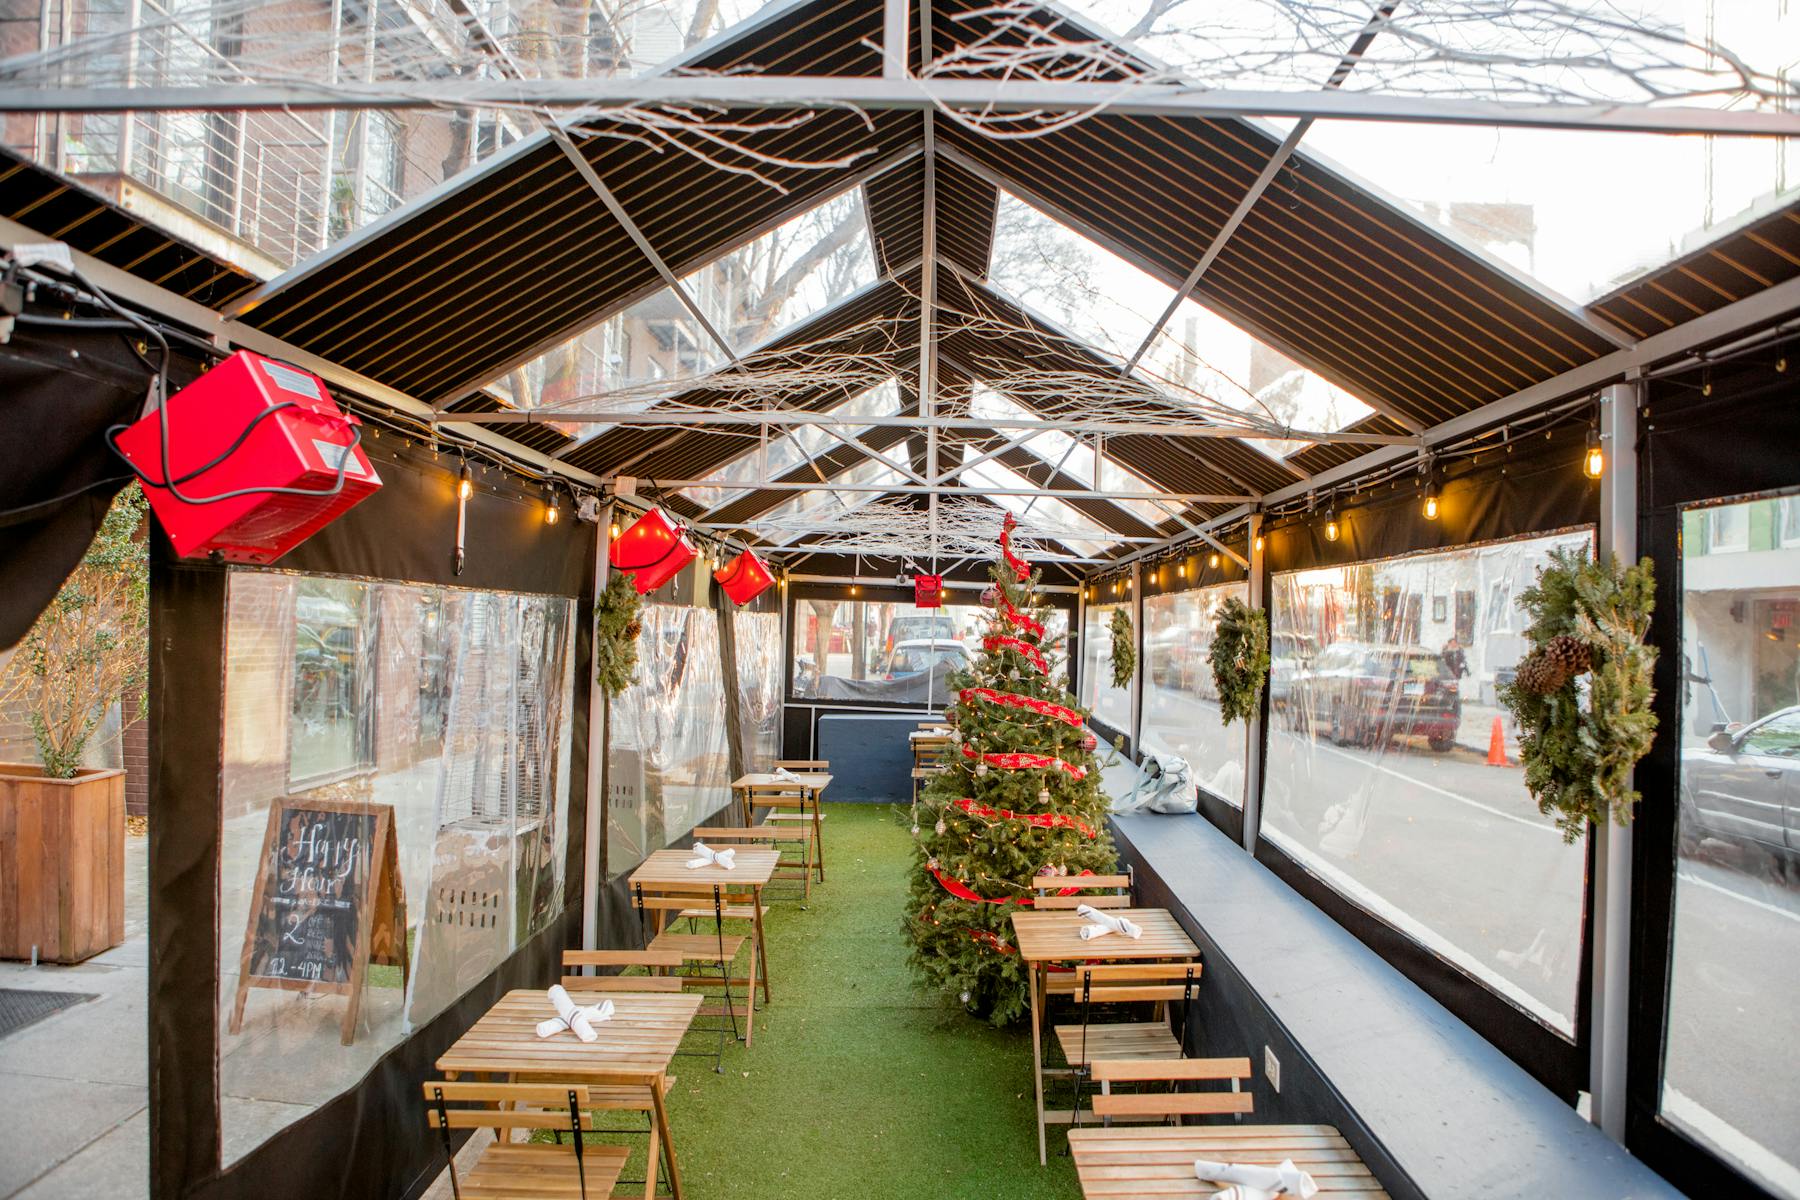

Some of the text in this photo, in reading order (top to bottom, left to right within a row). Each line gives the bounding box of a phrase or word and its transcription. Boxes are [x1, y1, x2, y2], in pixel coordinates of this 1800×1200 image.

[280, 823, 358, 878] Happy
[280, 867, 341, 894] Hour
[283, 914, 304, 945] 2
